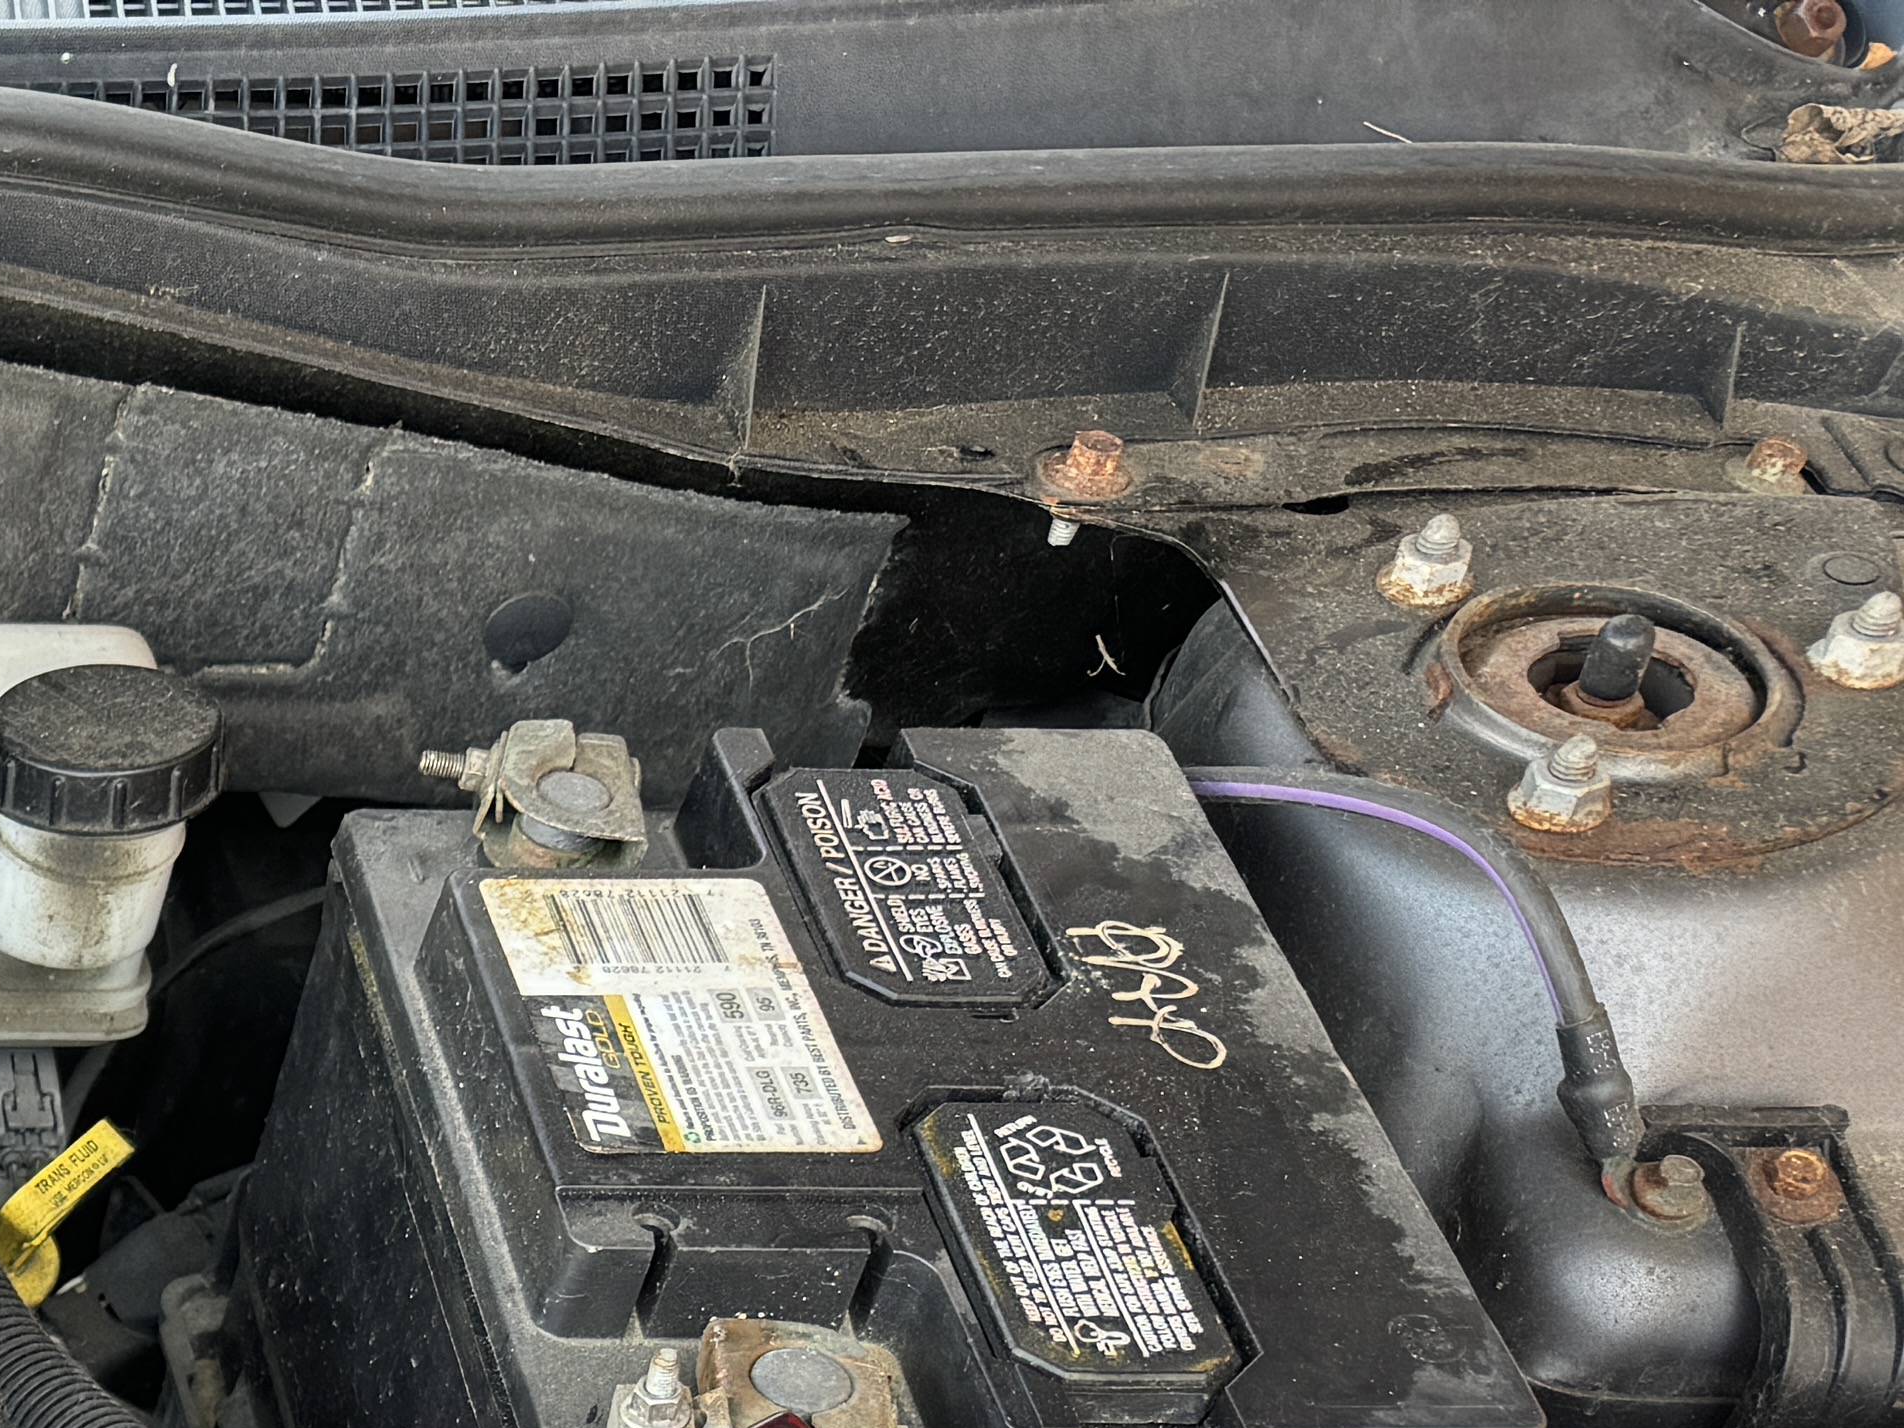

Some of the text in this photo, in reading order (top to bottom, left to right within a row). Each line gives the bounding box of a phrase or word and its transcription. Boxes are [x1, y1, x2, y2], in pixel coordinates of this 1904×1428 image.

[793, 792, 846, 857] POISON
[868, 778, 916, 843] SULFURIC ACID
[897, 801, 931, 843] CAN CAUSE
[909, 863, 933, 880] NO
[831, 876, 889, 952] DANGER
[885, 898, 916, 932] SHIELD
[907, 907, 934, 932] EYES
[923, 904, 964, 954] EXPLOSIVE
[952, 923, 983, 954] GASES
[713, 991, 746, 1019] 590
[754, 997, 776, 1011] 95
[582, 1009, 622, 1068] GOLD
[790, 1012, 819, 1041] PARTS,
[804, 1043, 826, 1062] BEST
[538, 1005, 634, 1142] Duralast
[617, 1022, 671, 1124] PROVEN TOUGH
[788, 1071, 813, 1093] 735
[814, 1064, 832, 1076] BY
[753, 1069, 789, 1117] 96R-DLG
[820, 1077, 857, 1129] DISTRIBUTED
[958, 1129, 983, 1154] LEVEL
[33, 1137, 100, 1196] TRANS FLUID
[971, 1156, 992, 1176] AND
[1092, 1137, 1123, 1177] RECYCLE
[980, 1178, 1005, 1204] TIGHT
[951, 1146, 1043, 1321] KEEP OUT OF THE REACH OF CHILDREN
[994, 1207, 1017, 1231] CAPS
[1006, 1233, 1029, 1257] VENT
[1049, 1238, 1073, 1256] GET
[1015, 1204, 1081, 1316] FLUSH EYES IMMEDIATELY
[1017, 1259, 1041, 1283] KEEP
[1063, 1228, 1120, 1316] MEDICAL HELP FAST
[1038, 1306, 1060, 1325] NOT
[1074, 1294, 1101, 1316] WITH
[1048, 1328, 1067, 1341] DO
